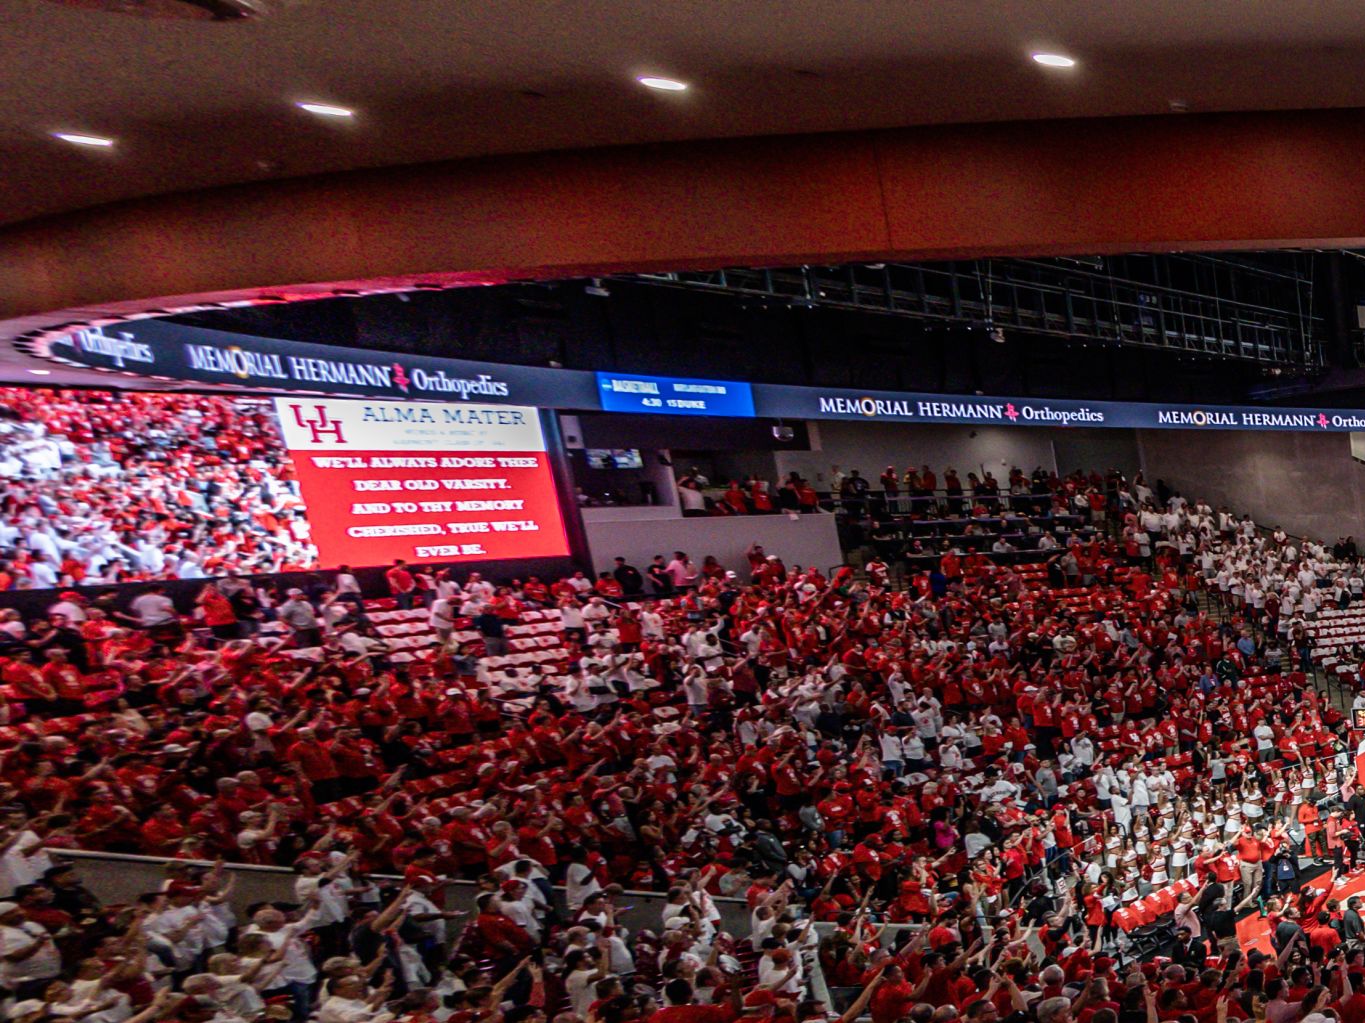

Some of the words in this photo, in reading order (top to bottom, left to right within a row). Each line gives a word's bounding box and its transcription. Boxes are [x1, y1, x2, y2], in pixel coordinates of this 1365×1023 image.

[187, 344, 288, 378] MEMORIAL
[290, 356, 391, 388] HERMANN
[409, 368, 509, 399] Orthopedics
[363, 406, 435, 424] ALMA
[442, 408, 527, 425] MATER
[819, 397, 912, 416] MEMORIAL
[917, 402, 1002, 418] HERMANN
[1022, 406, 1104, 424] Orthopedics
[289, 404, 348, 443] UH
[1158, 411, 1238, 425] MEMORIAL
[1242, 414, 1315, 427] HERMANN
[370, 457, 438, 468] ALWAYS
[440, 457, 496, 468] ADORE
[496, 457, 539, 468] THEE
[353, 480, 403, 491] DEAR
[403, 480, 440, 490] OLD
[352, 503, 391, 514] AND
[392, 502, 418, 513] TO
[419, 501, 453, 513] THY
[455, 500, 524, 512] MEMORY
[348, 524, 447, 538] CHERISHED,
[447, 522, 490, 534] TRUE
[415, 545, 460, 558] EVER
